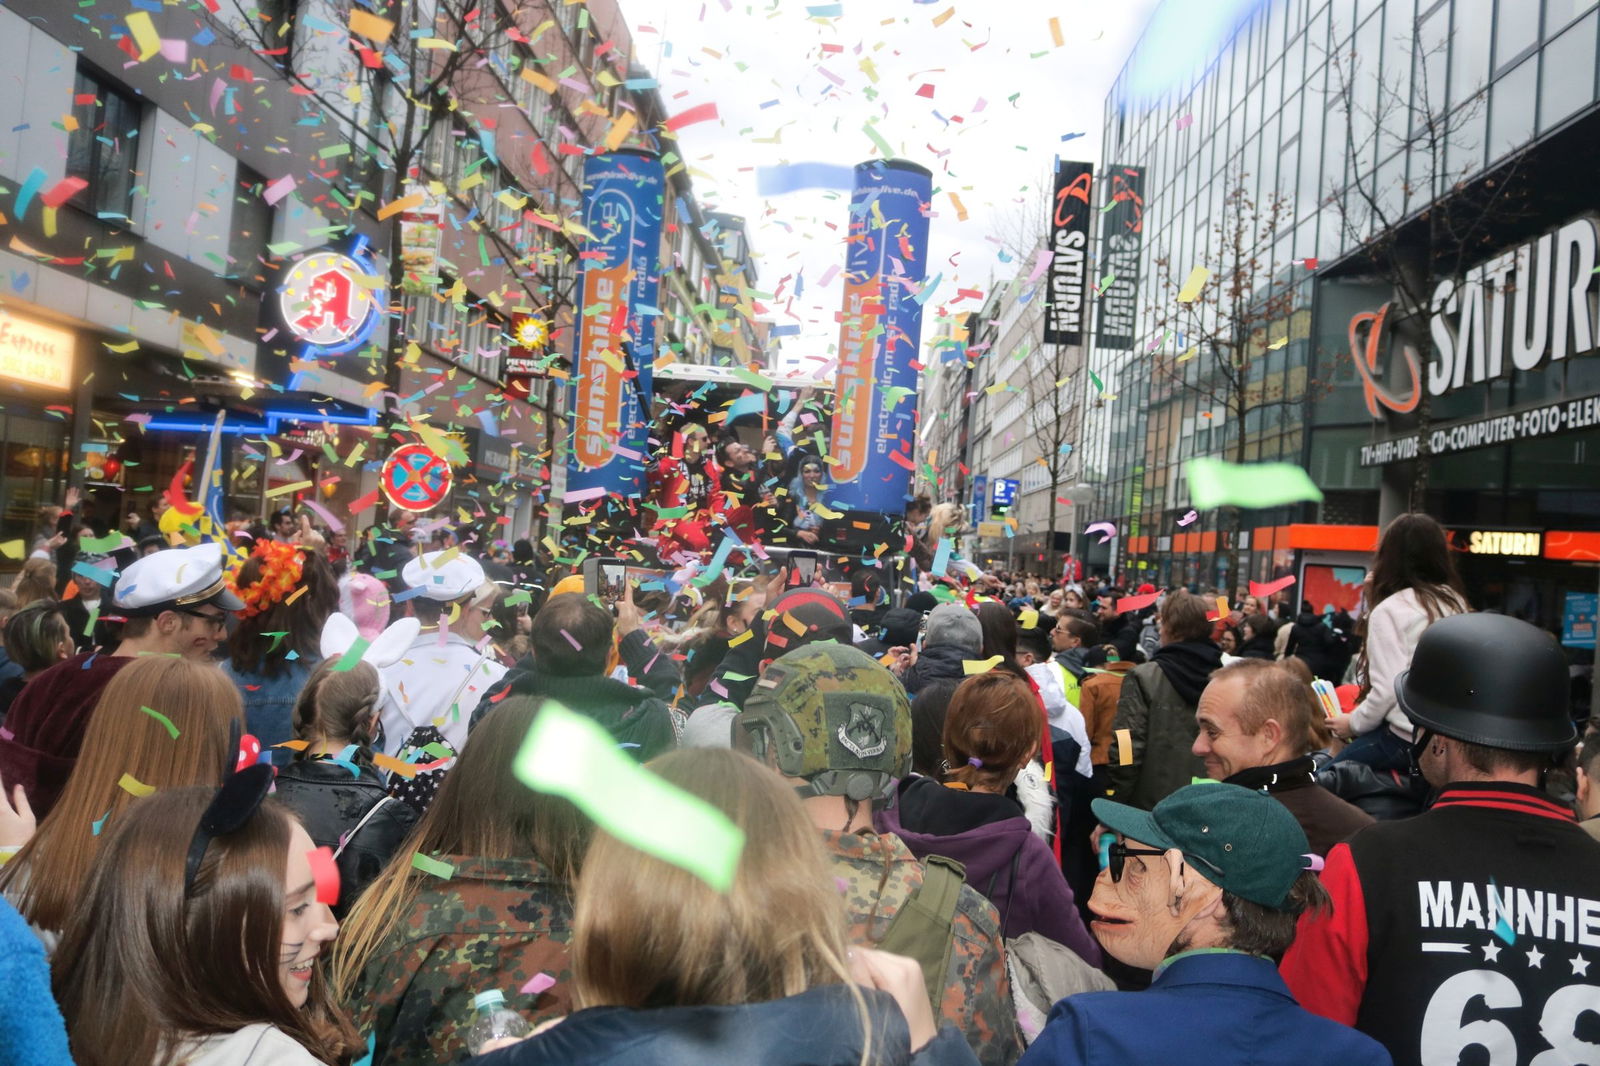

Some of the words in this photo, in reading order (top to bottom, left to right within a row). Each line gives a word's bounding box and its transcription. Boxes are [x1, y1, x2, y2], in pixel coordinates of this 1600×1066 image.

[887, 268, 901, 311] rado
[1050, 229, 1086, 333] SATURN
[1428, 218, 1600, 396] SATUR
[586, 278, 614, 456] sunshine
[626, 357, 641, 440] electric
[635, 256, 648, 299] radio
[884, 316, 898, 366] msic
[1396, 436, 1420, 460] VIDE
[1449, 418, 1516, 450] COMPUTER
[1521, 405, 1560, 437] FOTO
[1470, 531, 1540, 556] SATURN
[1418, 881, 1600, 948] MANNHE
